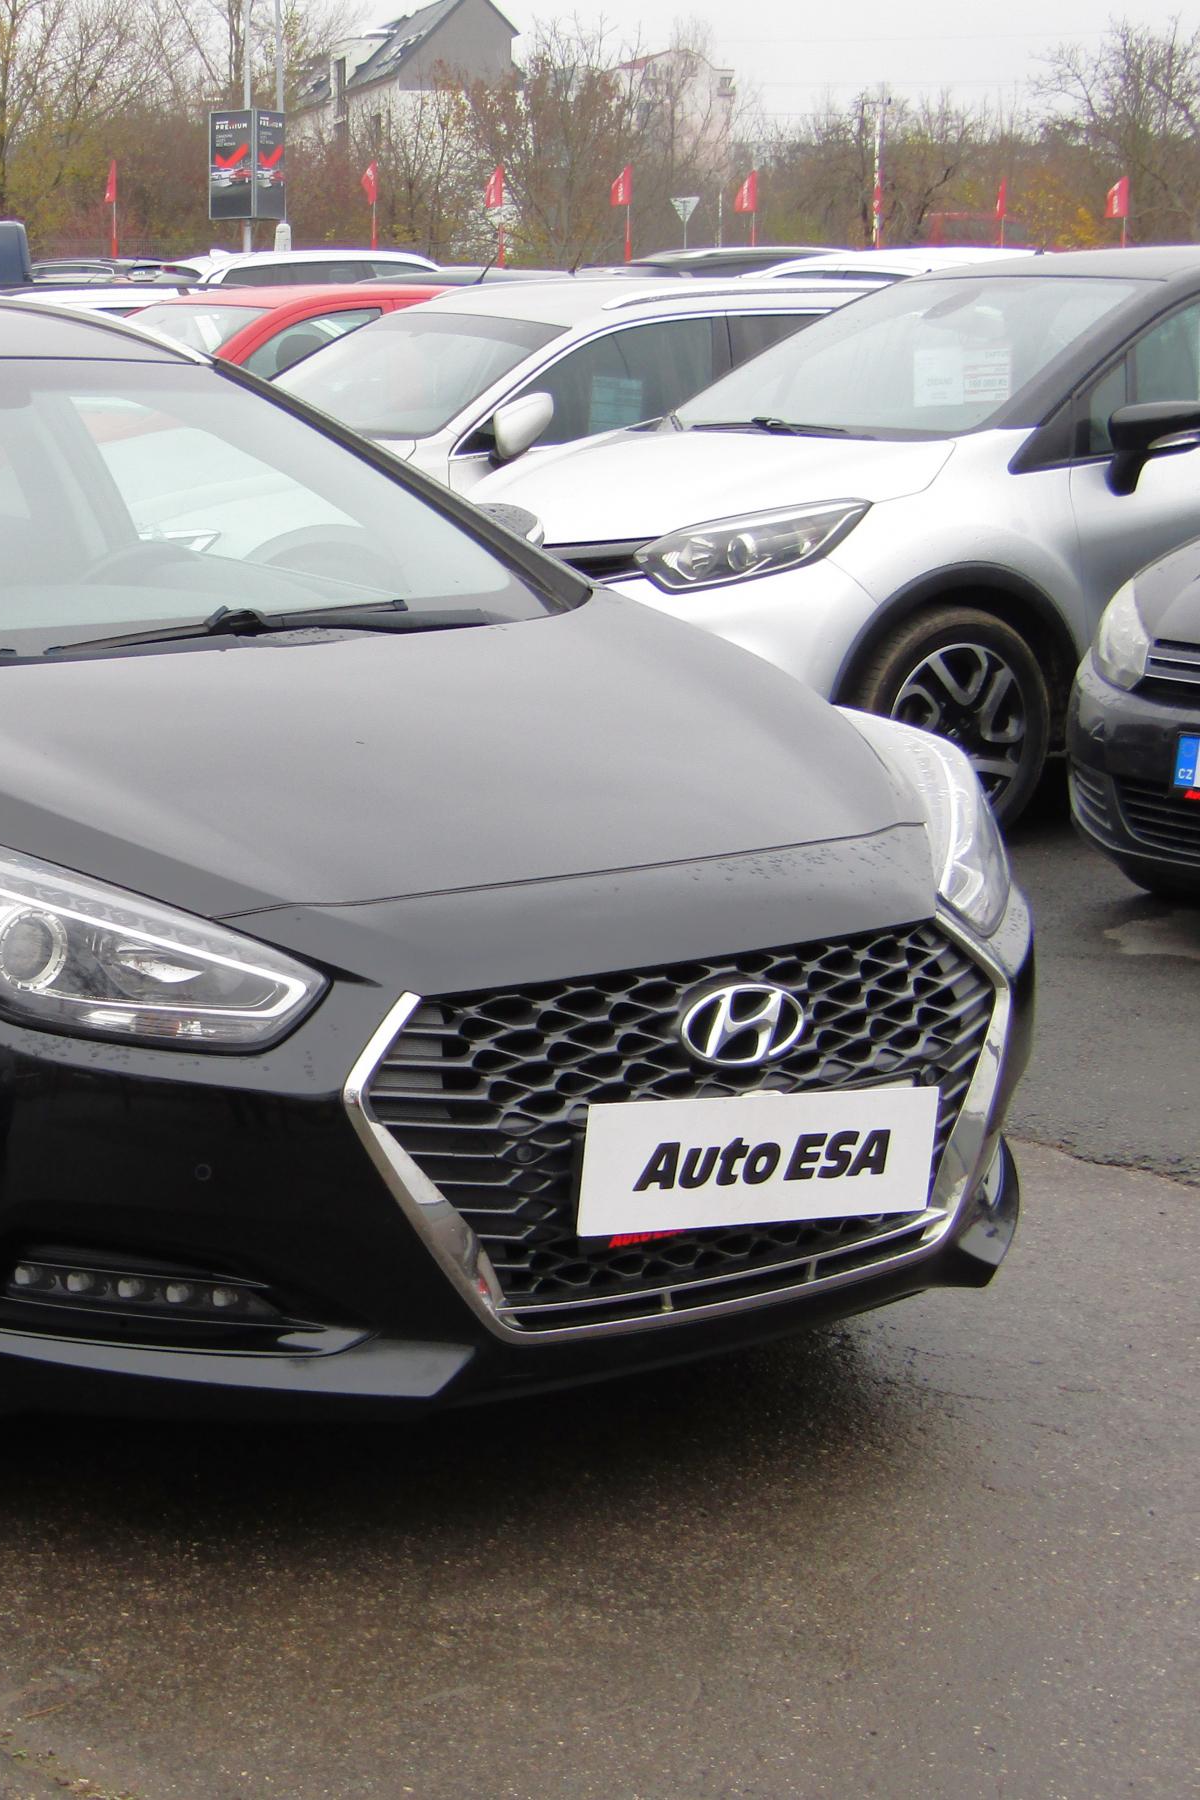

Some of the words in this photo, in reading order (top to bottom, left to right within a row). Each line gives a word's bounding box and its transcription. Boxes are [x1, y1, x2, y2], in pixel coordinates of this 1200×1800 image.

[1178, 768, 1193, 780] CZ
[632, 1137, 781, 1191] Auto
[783, 1129, 891, 1181] ESA
